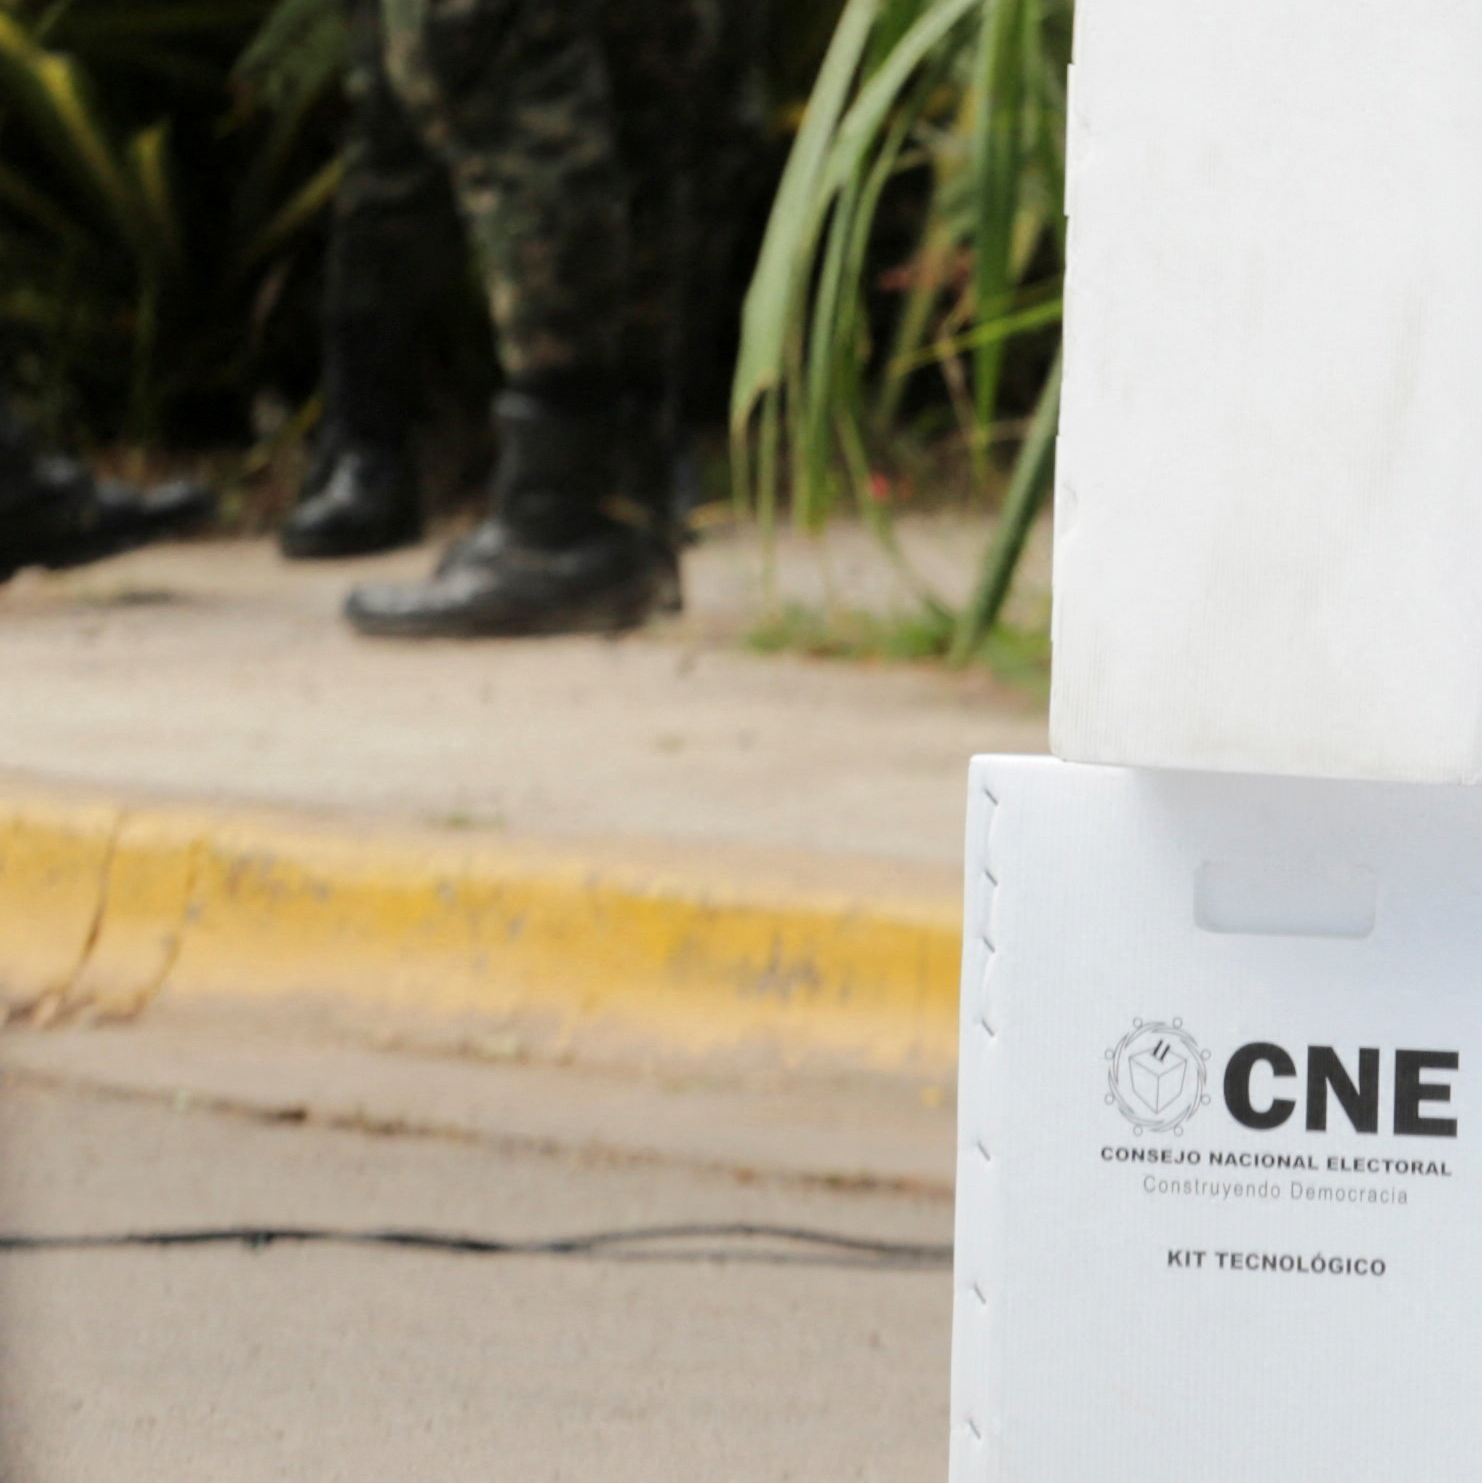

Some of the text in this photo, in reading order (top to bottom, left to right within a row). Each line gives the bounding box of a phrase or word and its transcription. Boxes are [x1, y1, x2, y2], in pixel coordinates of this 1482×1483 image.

[1222, 1041, 1460, 1139] CNE
[1100, 1146, 1451, 1177] CONSEJO NACIONAL ELECTORAL
[1142, 1173, 1408, 1206] Construyendo Democracia
[1167, 1249, 1387, 1277] KIT TECNOLÓGICO
